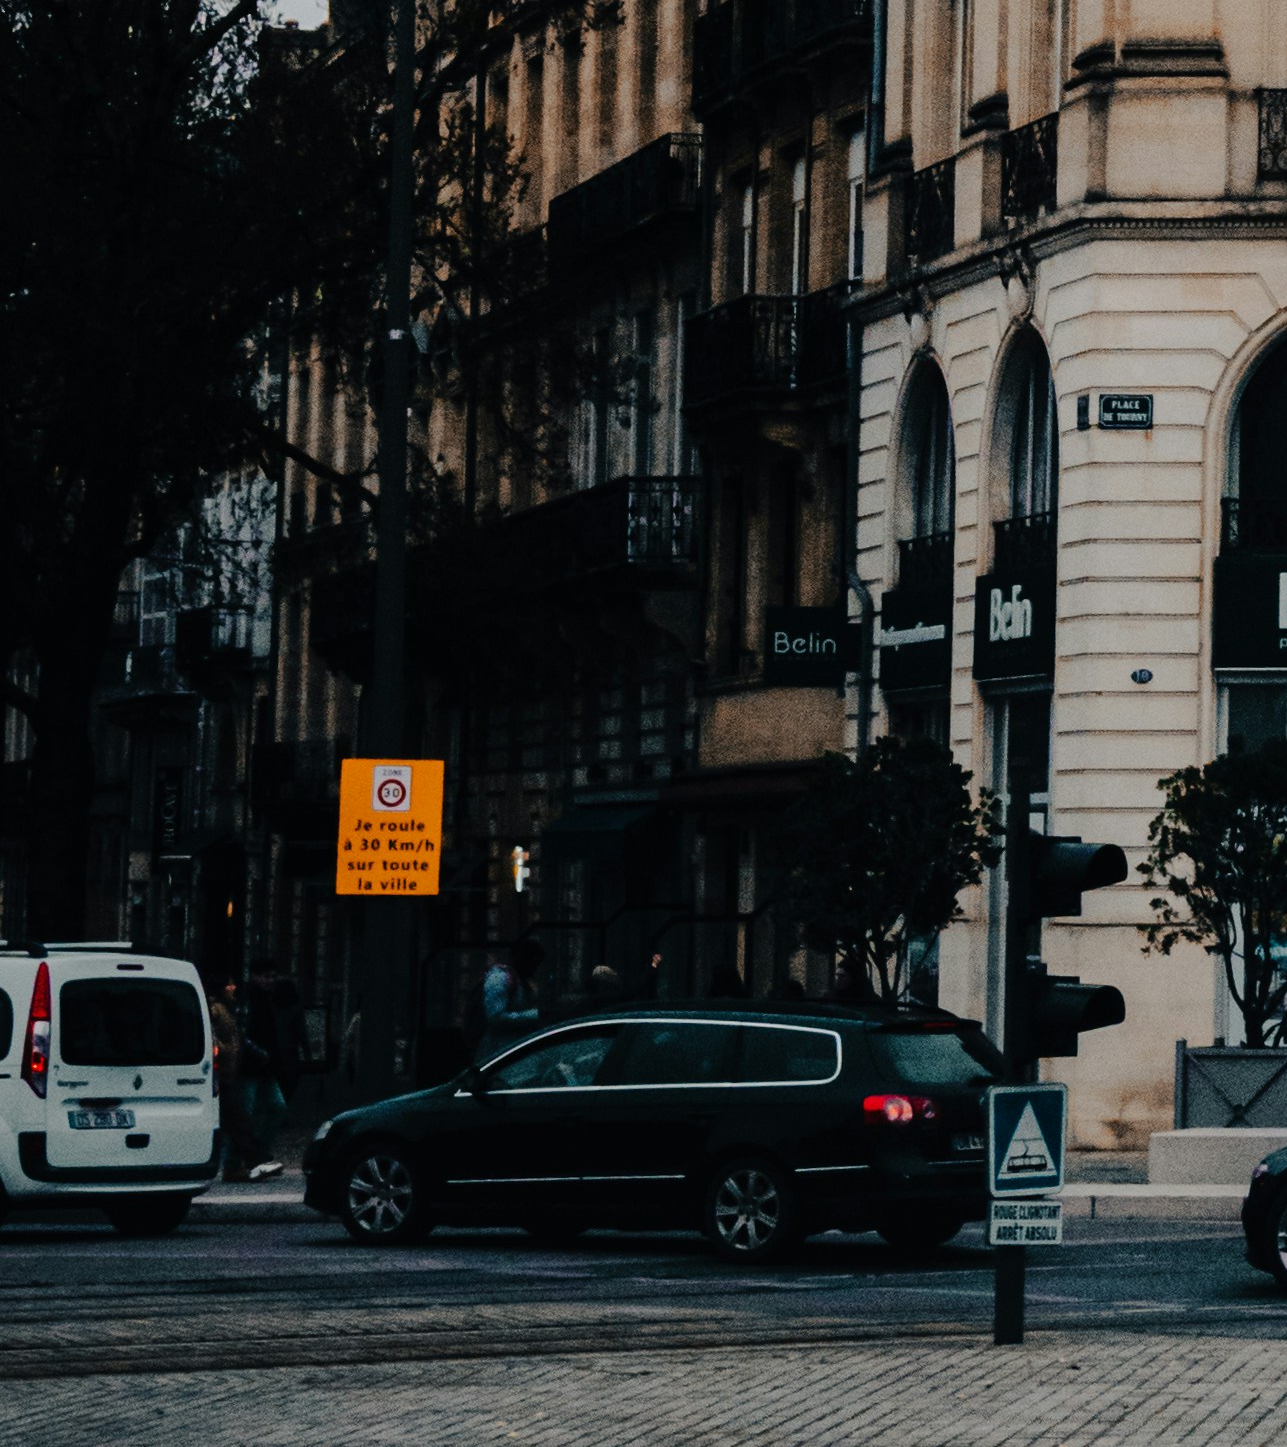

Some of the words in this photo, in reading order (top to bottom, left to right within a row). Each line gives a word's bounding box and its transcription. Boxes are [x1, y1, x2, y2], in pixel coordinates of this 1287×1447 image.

[1111, 400, 1140, 410] PLACE
[1104, 412, 1113, 422] DE
[989, 584, 1033, 643] Belin
[773, 631, 837, 654] Belin
[384, 787, 400, 799] 30
[354, 820, 372, 831] Je
[380, 820, 425, 831] roule
[343, 838, 352, 851] à
[361, 839, 380, 851] 30
[388, 839, 435, 852] Km/h
[348, 861, 374, 871] sur
[382, 860, 429, 871] toute
[358, 878, 372, 890] la
[380, 878, 417, 890] ville
[994, 1205, 1018, 1219] ROUGE
[996, 1222, 1023, 1240] ARRÊT
[1025, 1225, 1057, 1241] ABSOLU
